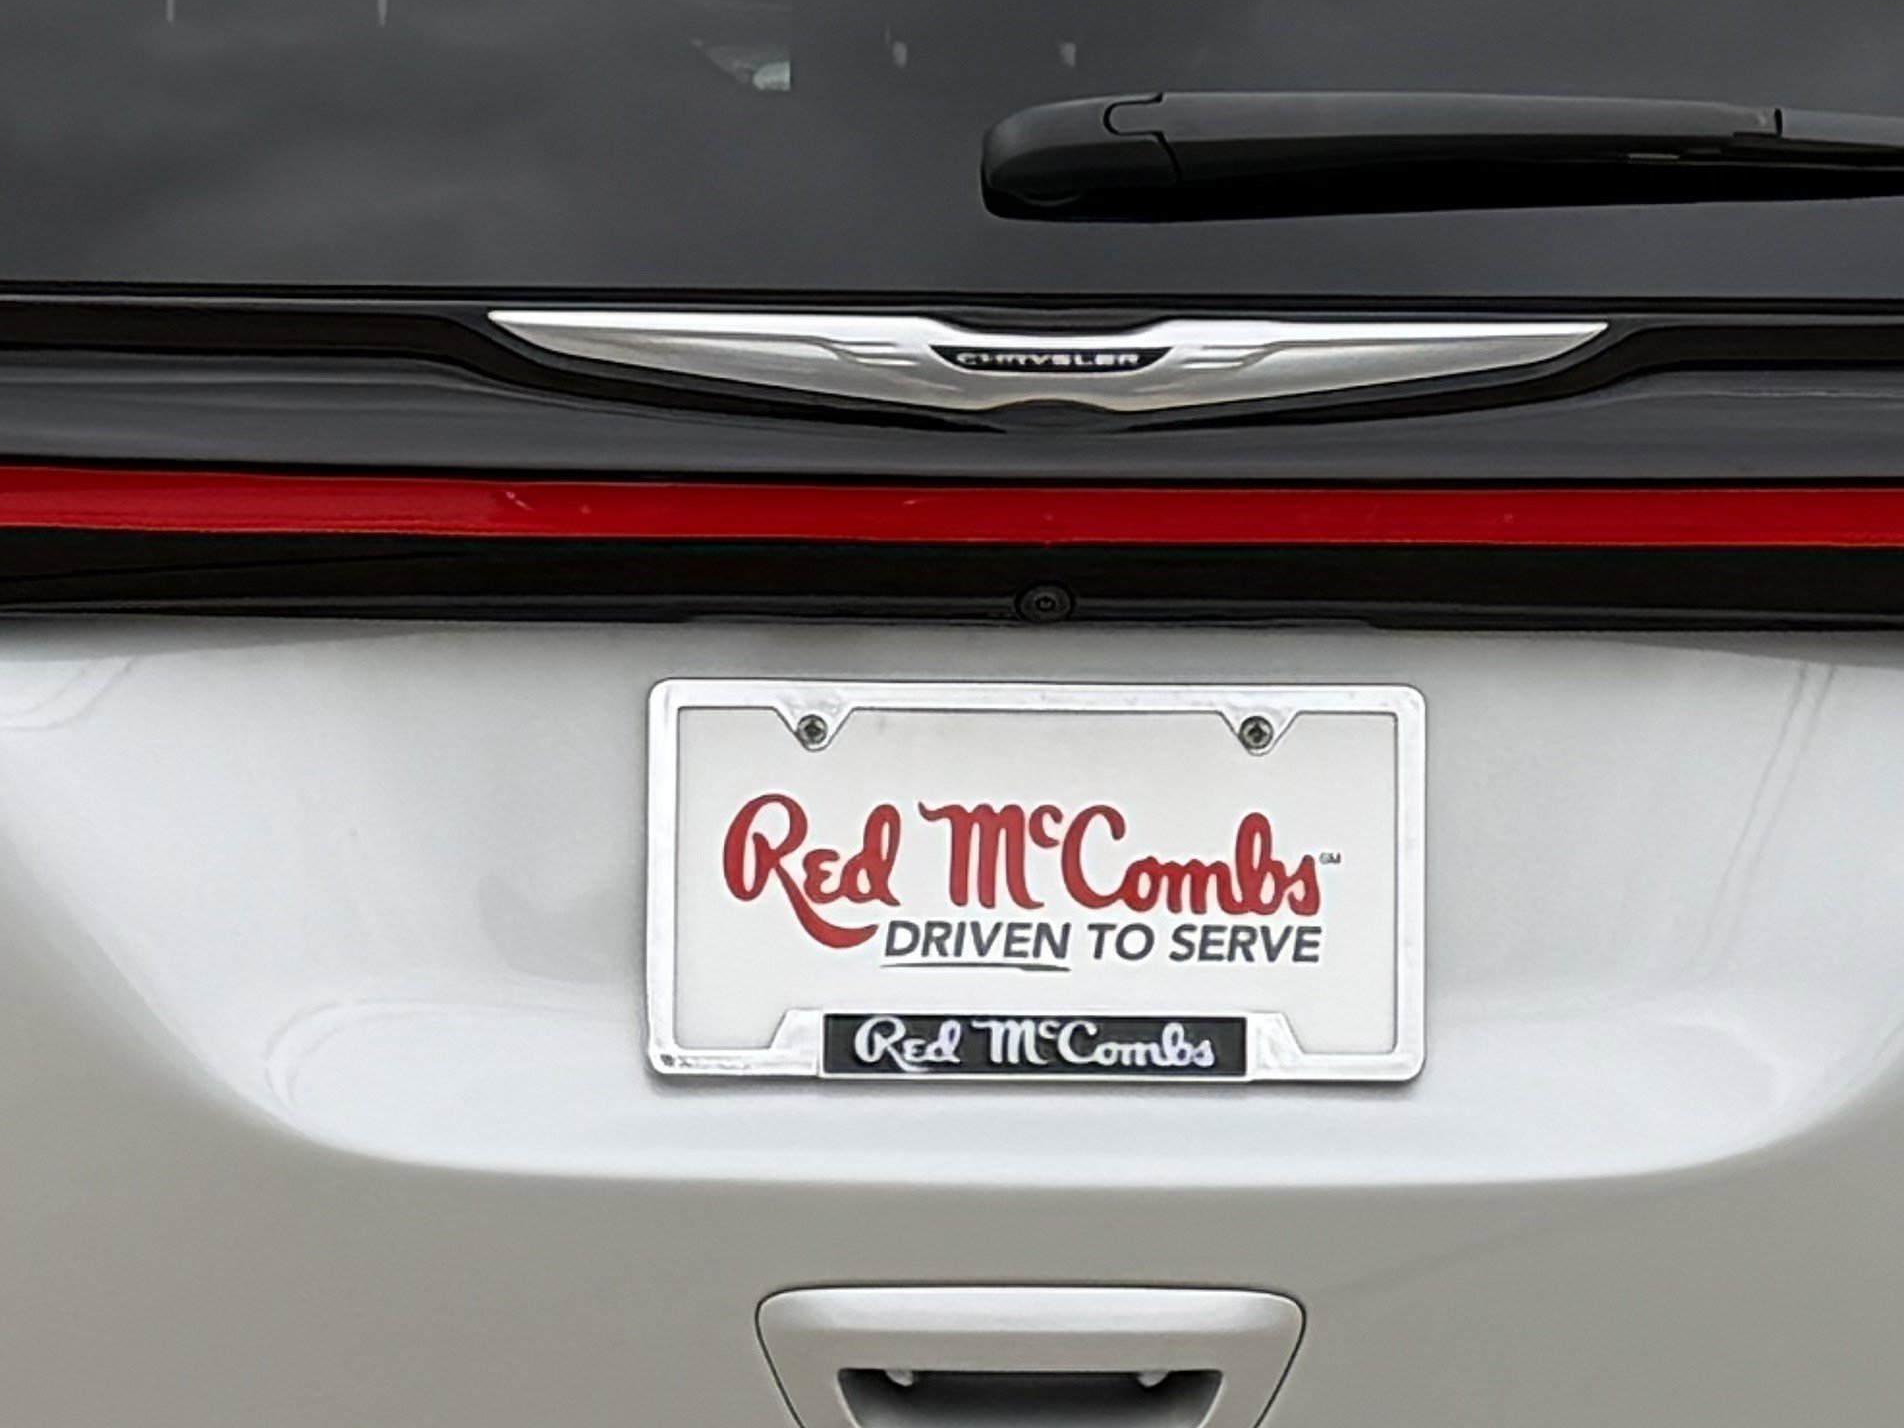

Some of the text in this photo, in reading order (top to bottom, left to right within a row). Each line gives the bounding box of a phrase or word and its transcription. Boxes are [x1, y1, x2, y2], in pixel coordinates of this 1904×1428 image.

[956, 352, 1140, 366] CHRYSLER
[723, 793, 902, 949] Red
[918, 801, 1321, 916] McCombs
[884, 920, 1322, 963] DRIVEN TO SERVE
[854, 1015, 1216, 1072] Red McCombs
